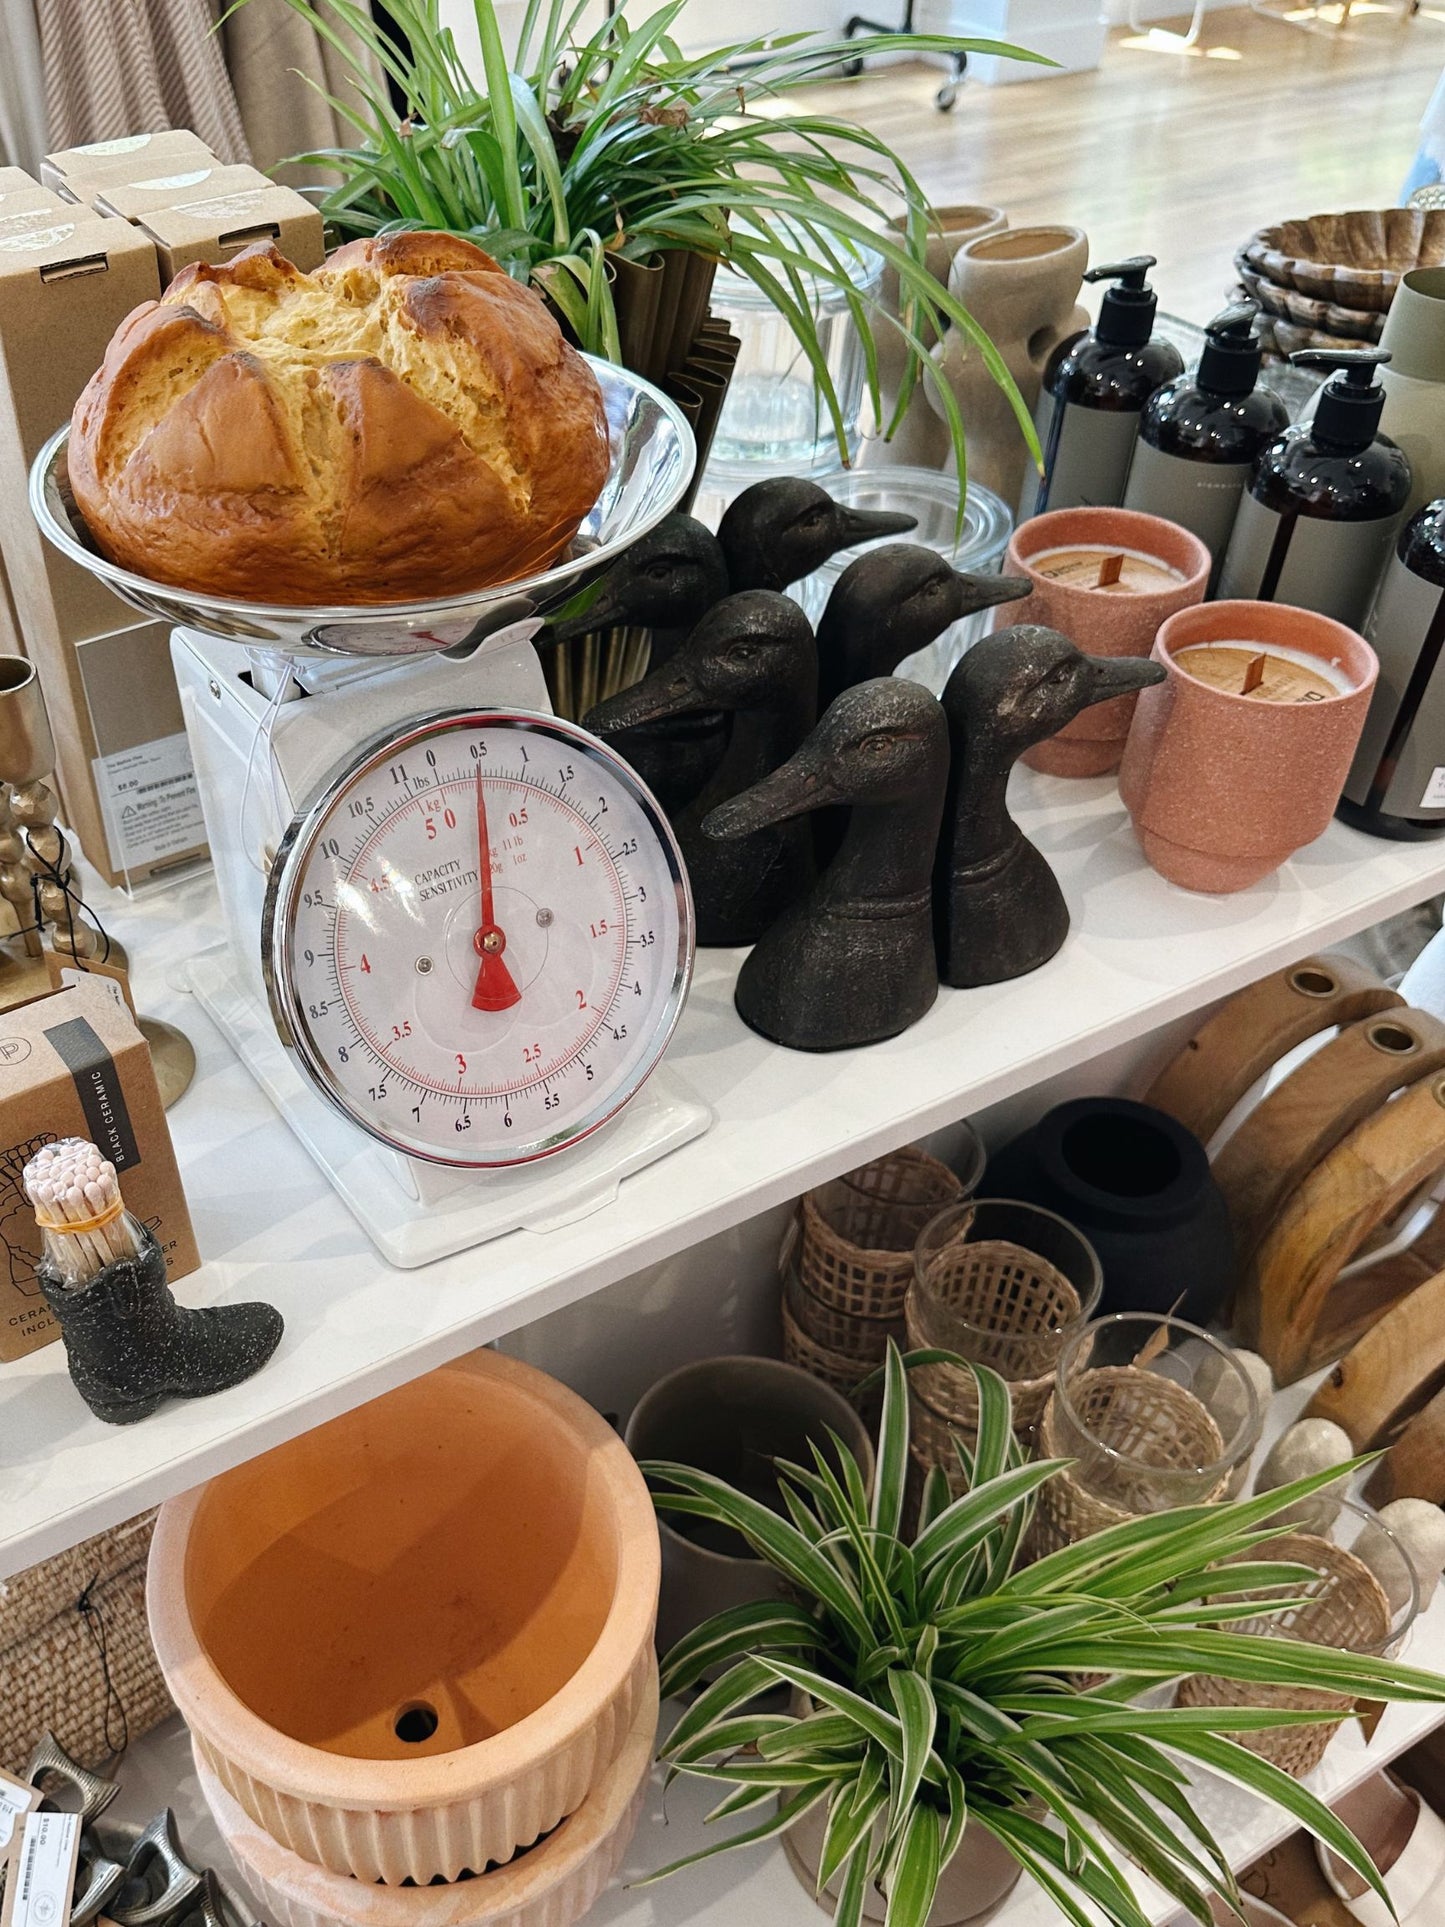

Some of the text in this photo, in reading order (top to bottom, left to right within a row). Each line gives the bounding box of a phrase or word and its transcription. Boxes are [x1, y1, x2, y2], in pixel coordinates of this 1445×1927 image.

[426, 749, 436, 767] 0
[469, 741, 488, 760] 0.5
[520, 745, 529, 763] 1
[389, 764, 409, 785] 11
[413, 776, 430, 790] lbs
[558, 765, 575, 783] 1.5
[348, 797, 375, 818] 10.5
[426, 799, 441, 813] kg
[598, 796, 609, 814] 2
[425, 808, 457, 840] 5 0
[508, 807, 529, 828] 0.5
[320, 838, 340, 860] 10
[573, 845, 585, 867] 1
[622, 838, 638, 856] 2.5
[414, 859, 461, 886] CAPACITY
[370, 874, 390, 894] 4.5
[419, 870, 478, 902] SENSITIVITY
[303, 890, 323, 908] 9.5
[637, 886, 647, 903] 3
[589, 919, 609, 940] 1.5
[639, 930, 656, 948] 3.5
[304, 949, 315, 968] 9
[360, 953, 371, 974] 4
[634, 981, 643, 997] 4
[576, 990, 587, 1010] 2
[309, 1001, 329, 1020] 8.5
[391, 1020, 412, 1042] 3.5
[613, 1025, 627, 1041] 4.5
[337, 1046, 349, 1063] 8
[522, 1043, 542, 1063] 2.5
[454, 1053, 467, 1075] 3
[585, 1065, 594, 1081] 5
[368, 1083, 387, 1102] 7.5
[544, 1093, 560, 1111] 5.5
[91, 1071, 125, 1163] BLACK CERAMIC
[412, 1107, 422, 1124] 7
[455, 1112, 472, 1133] 6.5
[504, 1111, 513, 1128] 6
[21, 1318, 55, 1336] INCL
